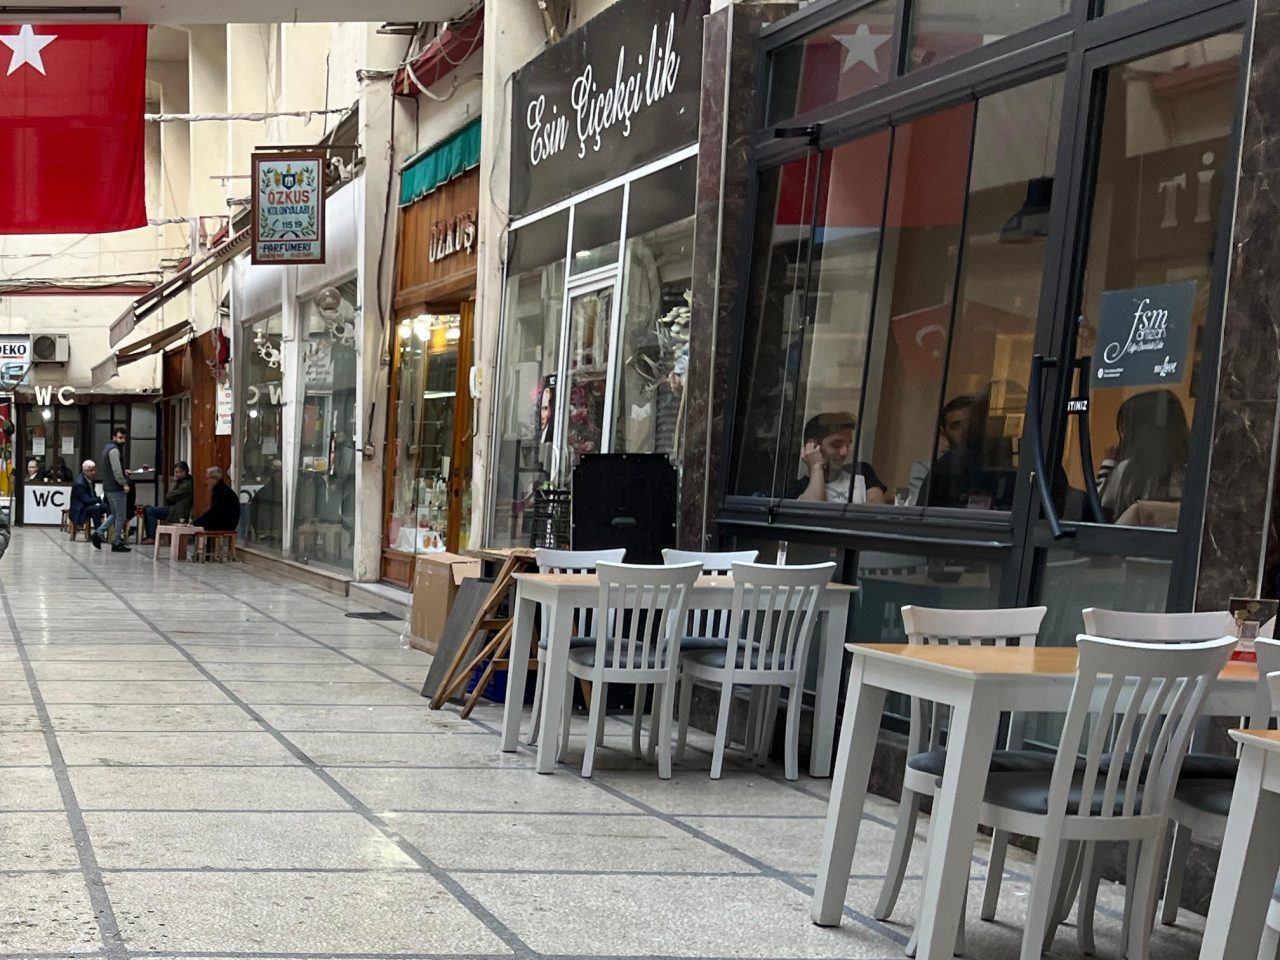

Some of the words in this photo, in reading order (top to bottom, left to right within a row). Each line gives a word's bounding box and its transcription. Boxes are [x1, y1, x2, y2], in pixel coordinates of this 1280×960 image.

[526, 95, 569, 165] Esin
[34, 385, 76, 406] WC
[33, 489, 65, 507] WC
